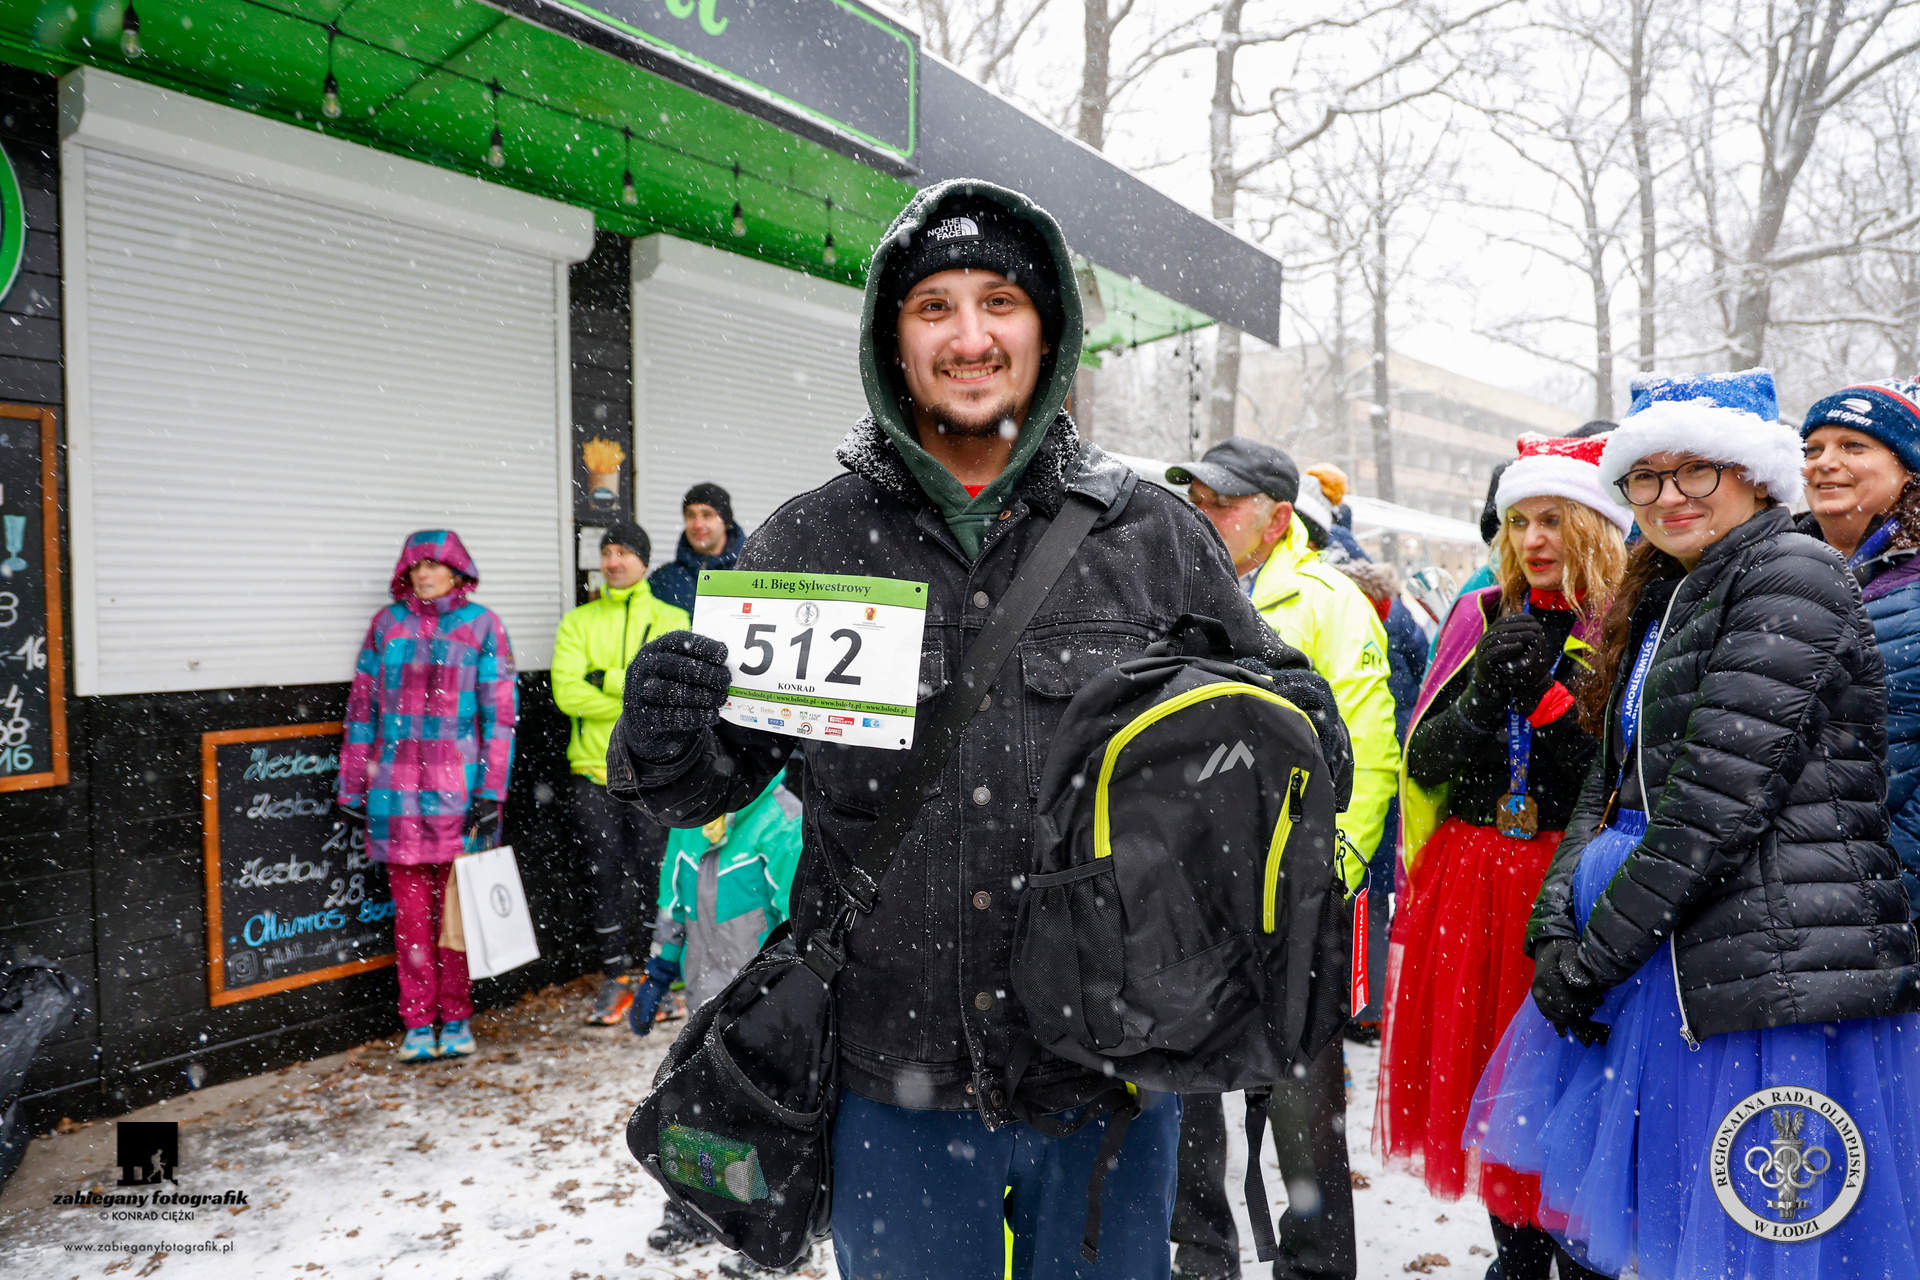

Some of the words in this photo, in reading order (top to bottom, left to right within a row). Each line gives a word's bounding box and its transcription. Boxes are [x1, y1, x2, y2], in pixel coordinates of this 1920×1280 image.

[927, 223, 961, 237] NORTH
[936, 230, 962, 241] FACE
[941, 217, 960, 226] THE
[752, 578, 768, 590] 41.
[771, 578, 796, 593] Bieg
[798, 579, 872, 595] Sylwestrowy
[738, 623, 862, 686] 512
[777, 682, 816, 694] KONRAD
[1623, 641, 1655, 718] SYLWESTROWY
[243, 747, 341, 786] Zestaw
[246, 791, 332, 820] Zestaw
[238, 853, 333, 888] Zestaw
[323, 873, 365, 907] 28
